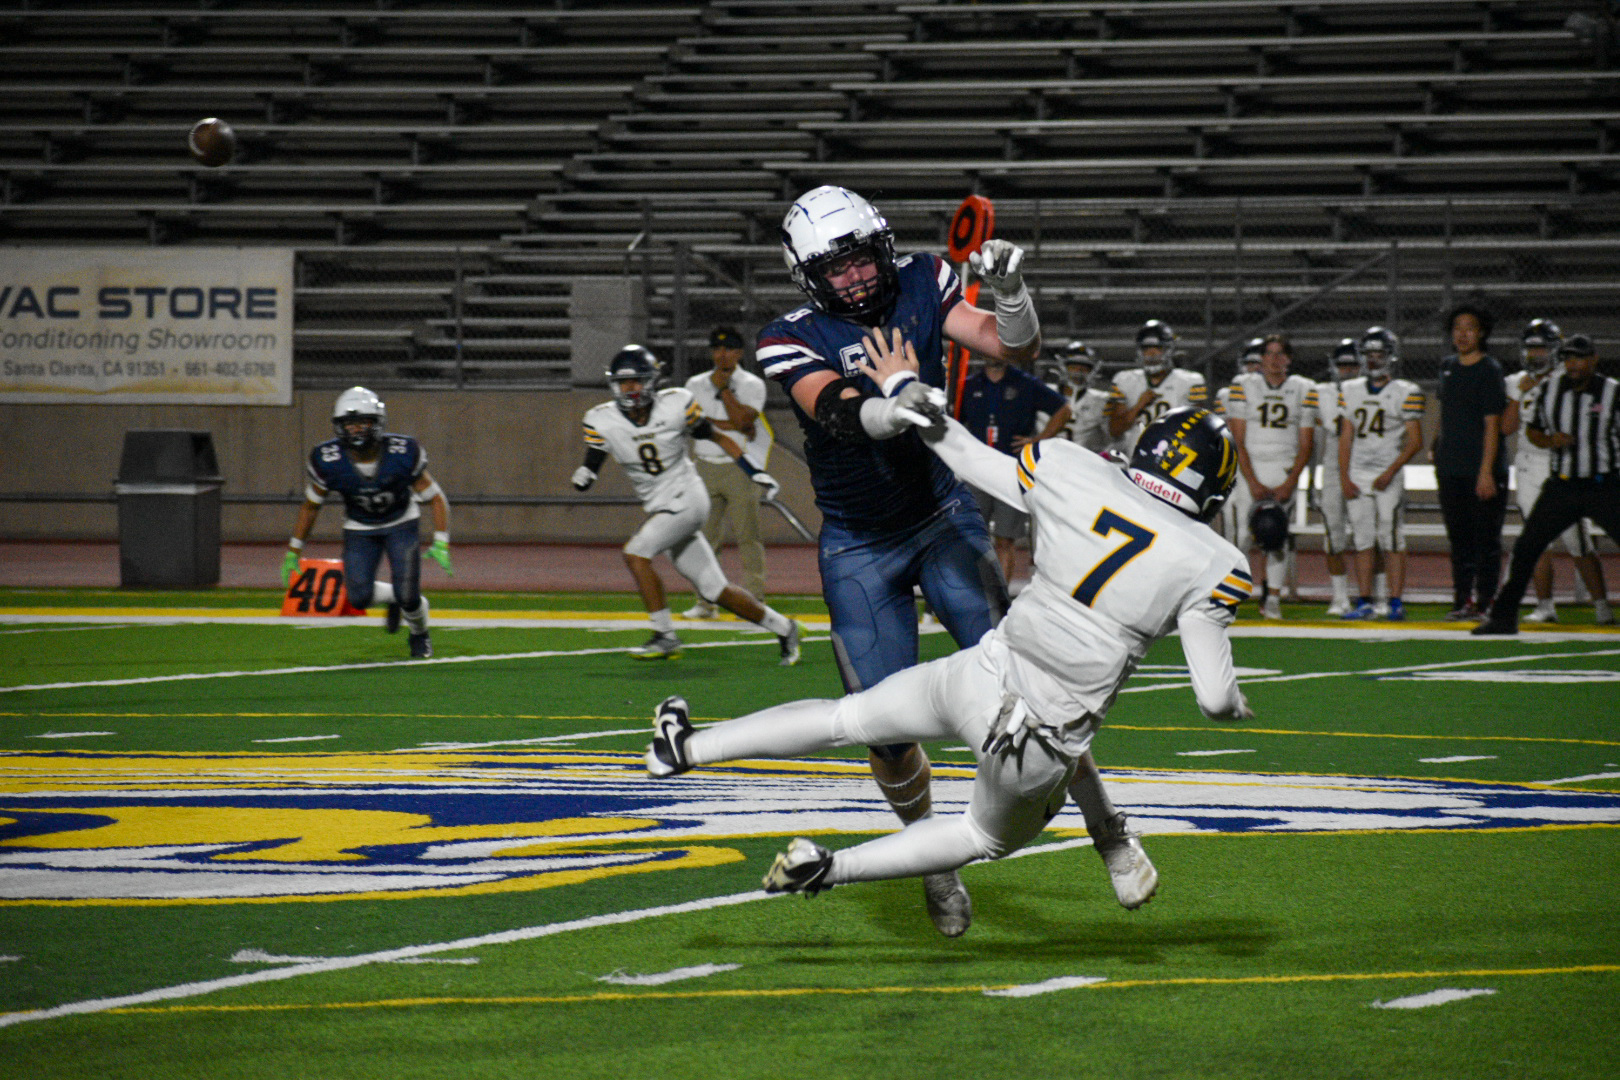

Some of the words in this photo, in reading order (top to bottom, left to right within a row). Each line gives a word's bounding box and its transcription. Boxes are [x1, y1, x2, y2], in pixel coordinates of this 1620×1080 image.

[98, 286, 277, 319] STORE
[0, 327, 140, 355] onditioning
[147, 328, 277, 351] Showroom
[103, 360, 123, 377] CA
[1257, 402, 1289, 429] 12
[1354, 408, 1386, 438] 24
[637, 442, 665, 476] 8
[1170, 444, 1198, 478] 7
[1133, 472, 1183, 504] Riddell
[1071, 506, 1158, 608] 7
[288, 567, 344, 613] 40
